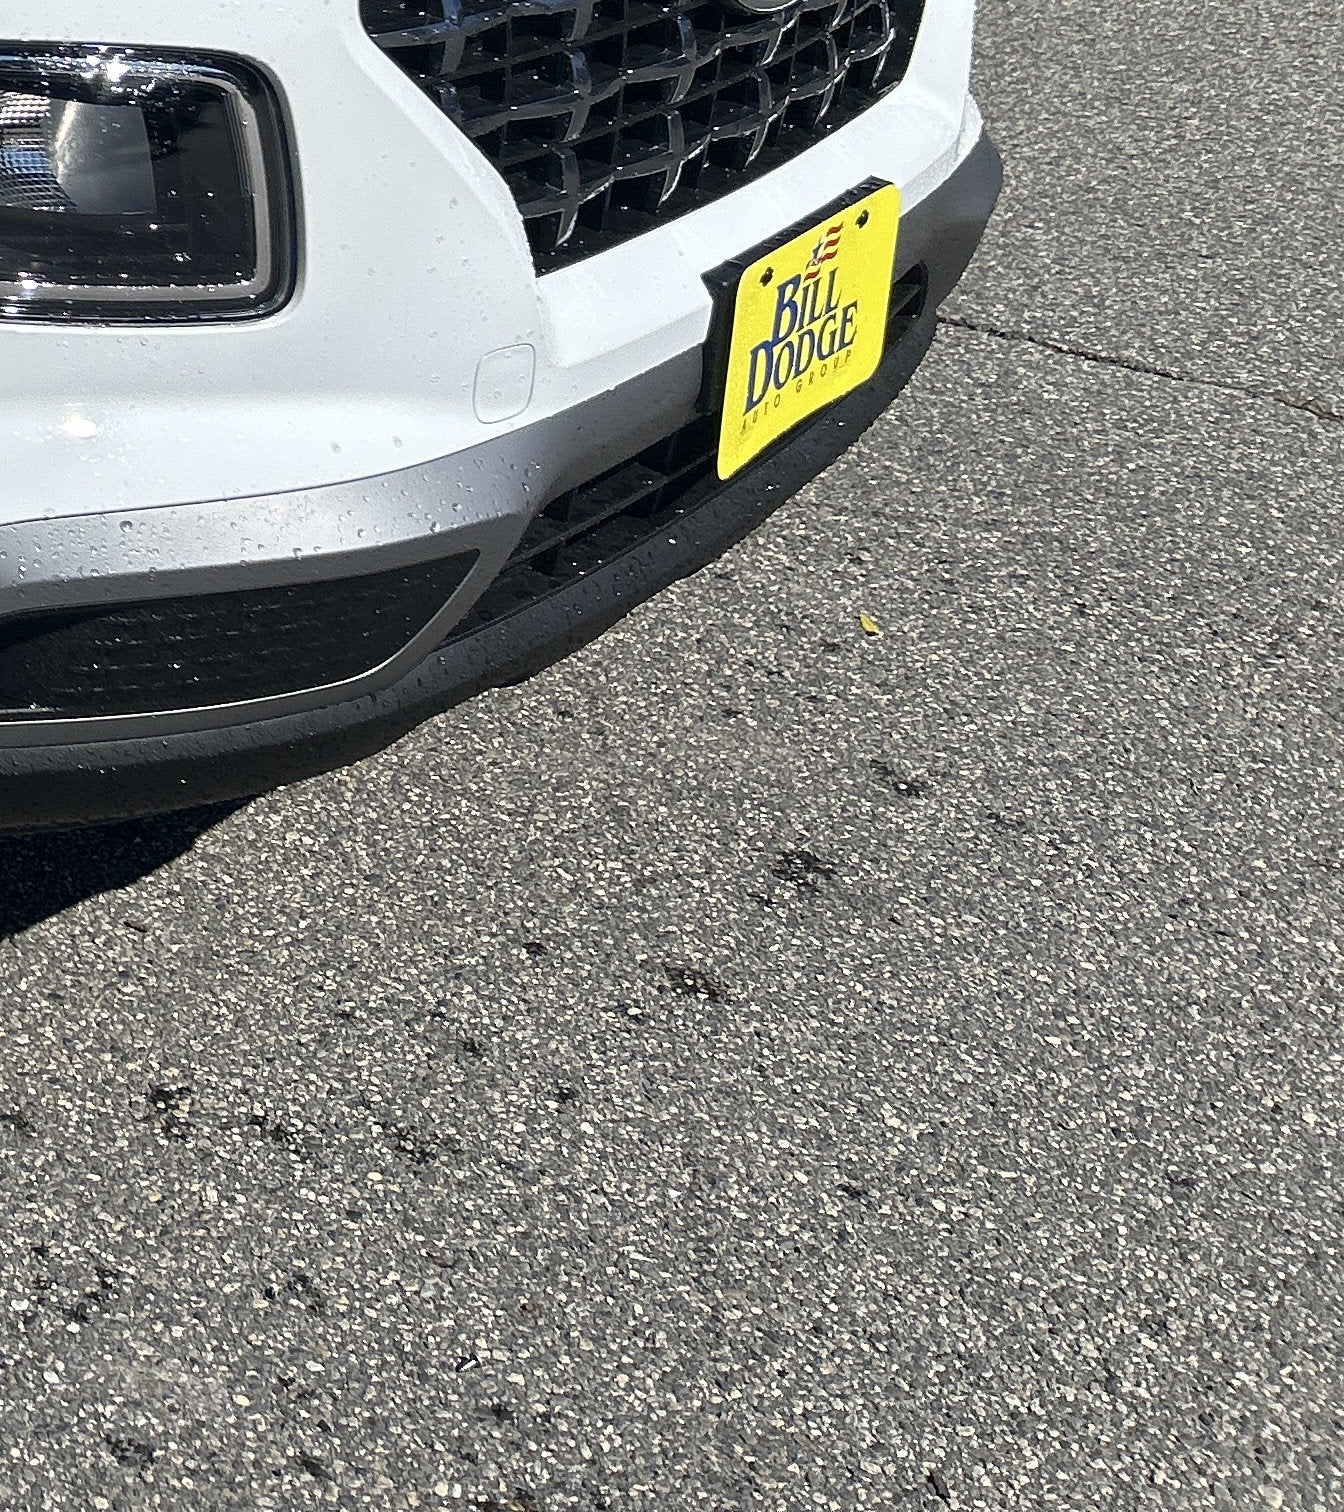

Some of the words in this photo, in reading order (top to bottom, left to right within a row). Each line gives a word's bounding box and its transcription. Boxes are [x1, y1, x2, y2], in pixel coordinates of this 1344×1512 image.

[771, 267, 843, 343] BILL
[740, 393, 781, 433] AUTO
[795, 349, 853, 393] GROUP
[745, 300, 859, 416] DODGE
